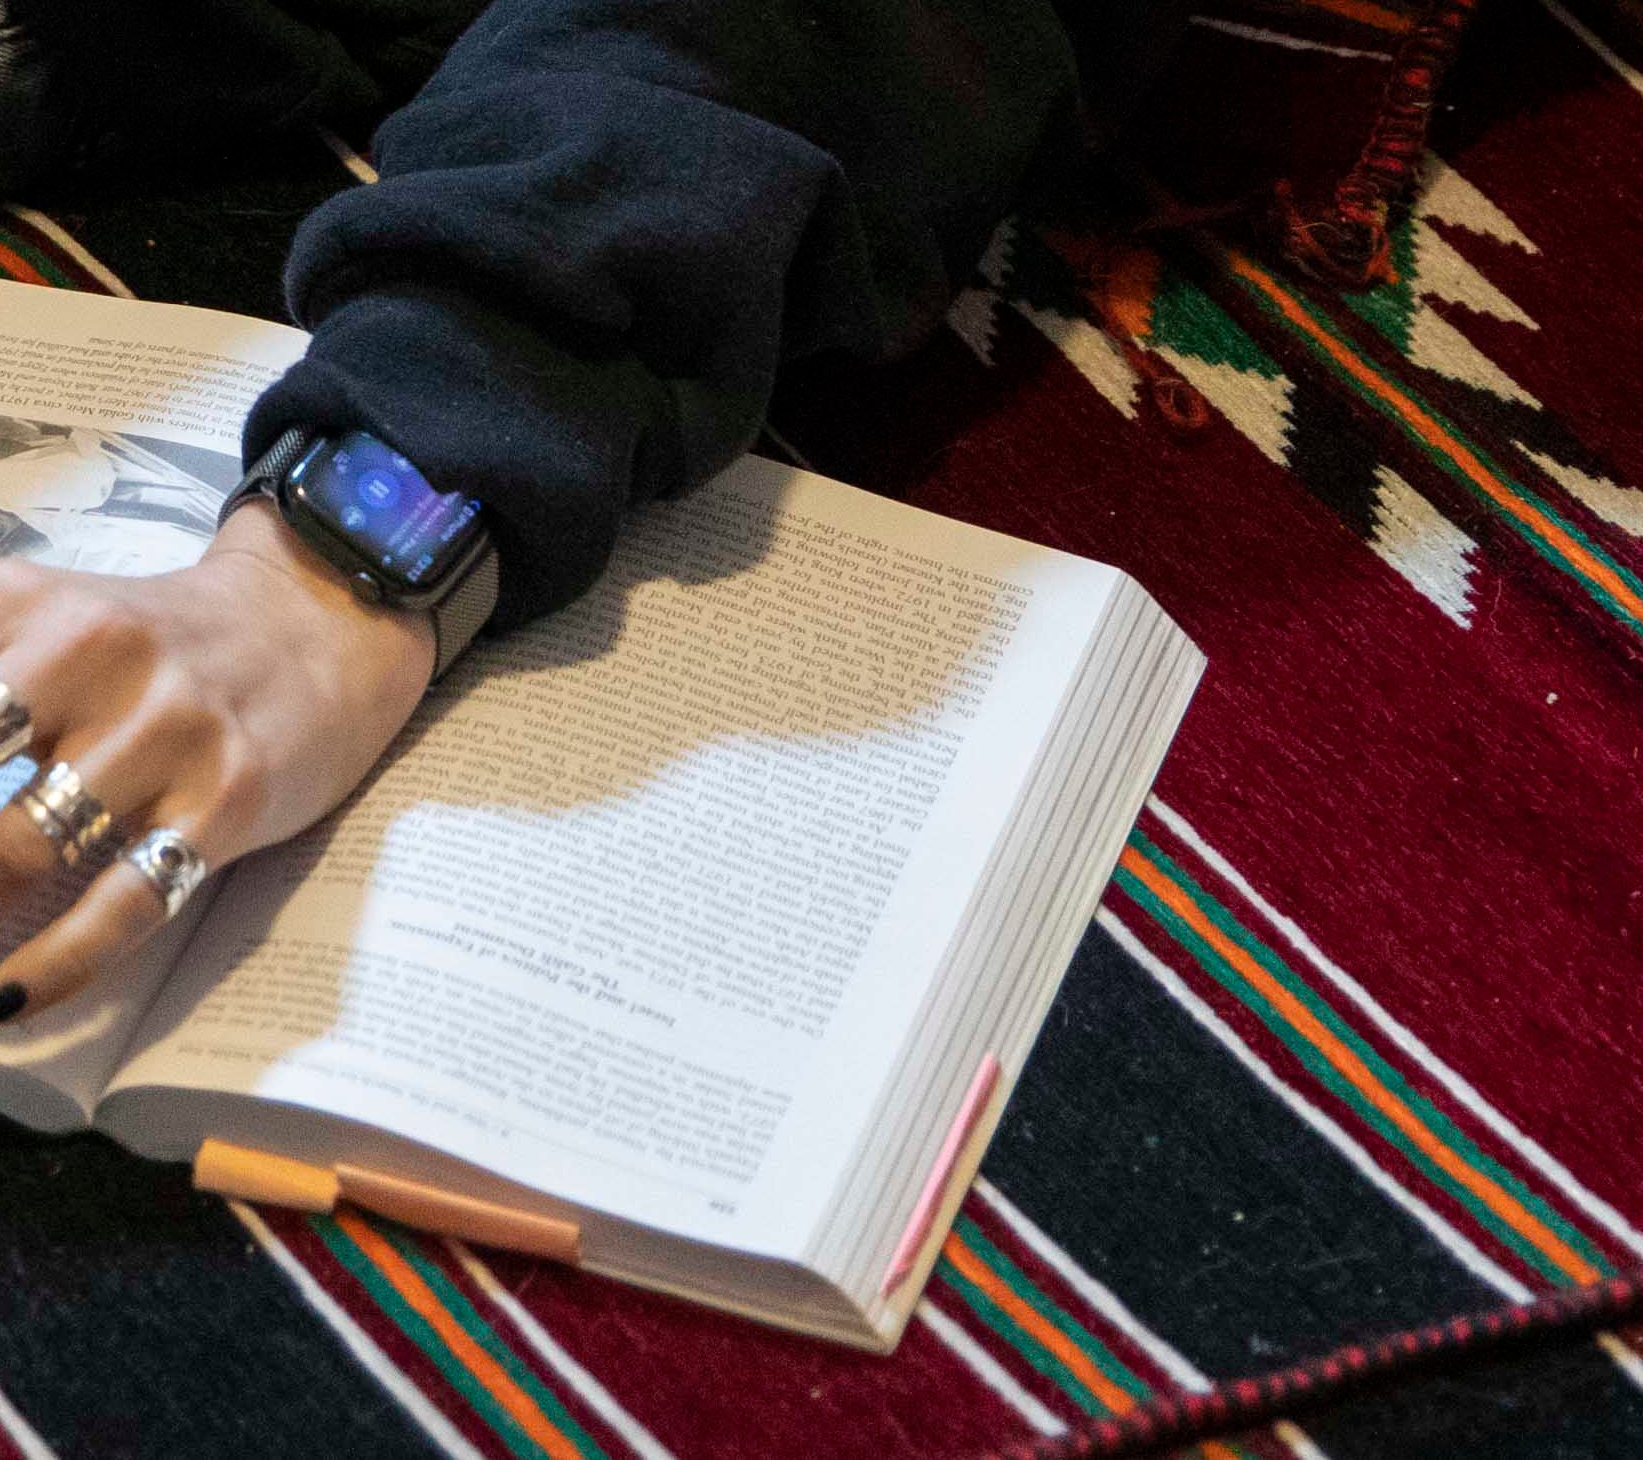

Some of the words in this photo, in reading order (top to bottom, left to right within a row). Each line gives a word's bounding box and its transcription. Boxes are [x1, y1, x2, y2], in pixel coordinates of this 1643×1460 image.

[31, 399, 62, 410] circa
[63, 403, 95, 415] Meir,
[96, 408, 134, 420] Golda
[136, 414, 164, 424] with
[812, 521, 835, 535] the
[836, 530, 852, 541] of
[855, 535, 888, 552] right
[795, 540, 859, 571] following
[890, 547, 943, 572] historic
[790, 569, 811, 582] for
[809, 559, 843, 579] King
[865, 566, 911, 588] Jordan
[890, 561, 943, 585] Knesset
[946, 565, 969, 578] the
[743, 580, 771, 594] only
[774, 576, 821, 599] further
[847, 574, 886, 593] when
[915, 583, 945, 598] with
[945, 580, 970, 592] the
[970, 573, 1034, 597] confirms
[649, 592, 664, 601] of
[818, 578, 904, 612] implications
[824, 594, 839, 604] to
[890, 588, 930, 608] 1972,
[971, 587, 997, 602] but
[669, 596, 703, 614] Most
[752, 596, 796, 617] would
[775, 589, 856, 623] envisioning
[936, 603, 951, 614] in
[952, 594, 1022, 622] federation
[639, 602, 699, 626] northern
[842, 600, 930, 634] manipulated
[910, 610, 937, 625] The
[956, 609, 1018, 633] emerged
[704, 622, 728, 636] the
[765, 615, 806, 635] where
[802, 613, 861, 639] outposts
[860, 620, 895, 638] Plan,
[732, 631, 748, 643] in
[787, 636, 806, 650] by
[813, 631, 847, 650] Bank
[899, 633, 939, 652] Allon
[934, 628, 973, 650] being
[986, 633, 1010, 646] the
[752, 638, 781, 654] and
[867, 636, 919, 659] defense
[941, 647, 965, 660] the
[978, 644, 1004, 656] was
[786, 649, 833, 671] Golan,
[811, 645, 862, 669] created
[853, 645, 885, 664] West
[924, 655, 939, 665] as
[971, 654, 999, 669] way
[866, 665, 884, 678] be
[894, 659, 915, 672] the
[943, 661, 993, 682] tended
[799, 669, 815, 680] of
[837, 668, 860, 682] the
[888, 672, 904, 683] to
[919, 667, 947, 682] and
[819, 674, 890, 708] beginning
[866, 678, 906, 698] Bank,
[908, 678, 982, 707] scheduled
[952, 678, 985, 694] Sinai
[893, 702, 917, 715] the
[911, 693, 946, 711] West
[922, 711, 940, 722] At
[952, 707, 977, 720] the
[477, 946, 496, 958] of
[500, 953, 559, 983] Politics
[565, 979, 590, 994] the
[593, 989, 626, 1007] and
[628, 1002, 676, 1028] Israel
